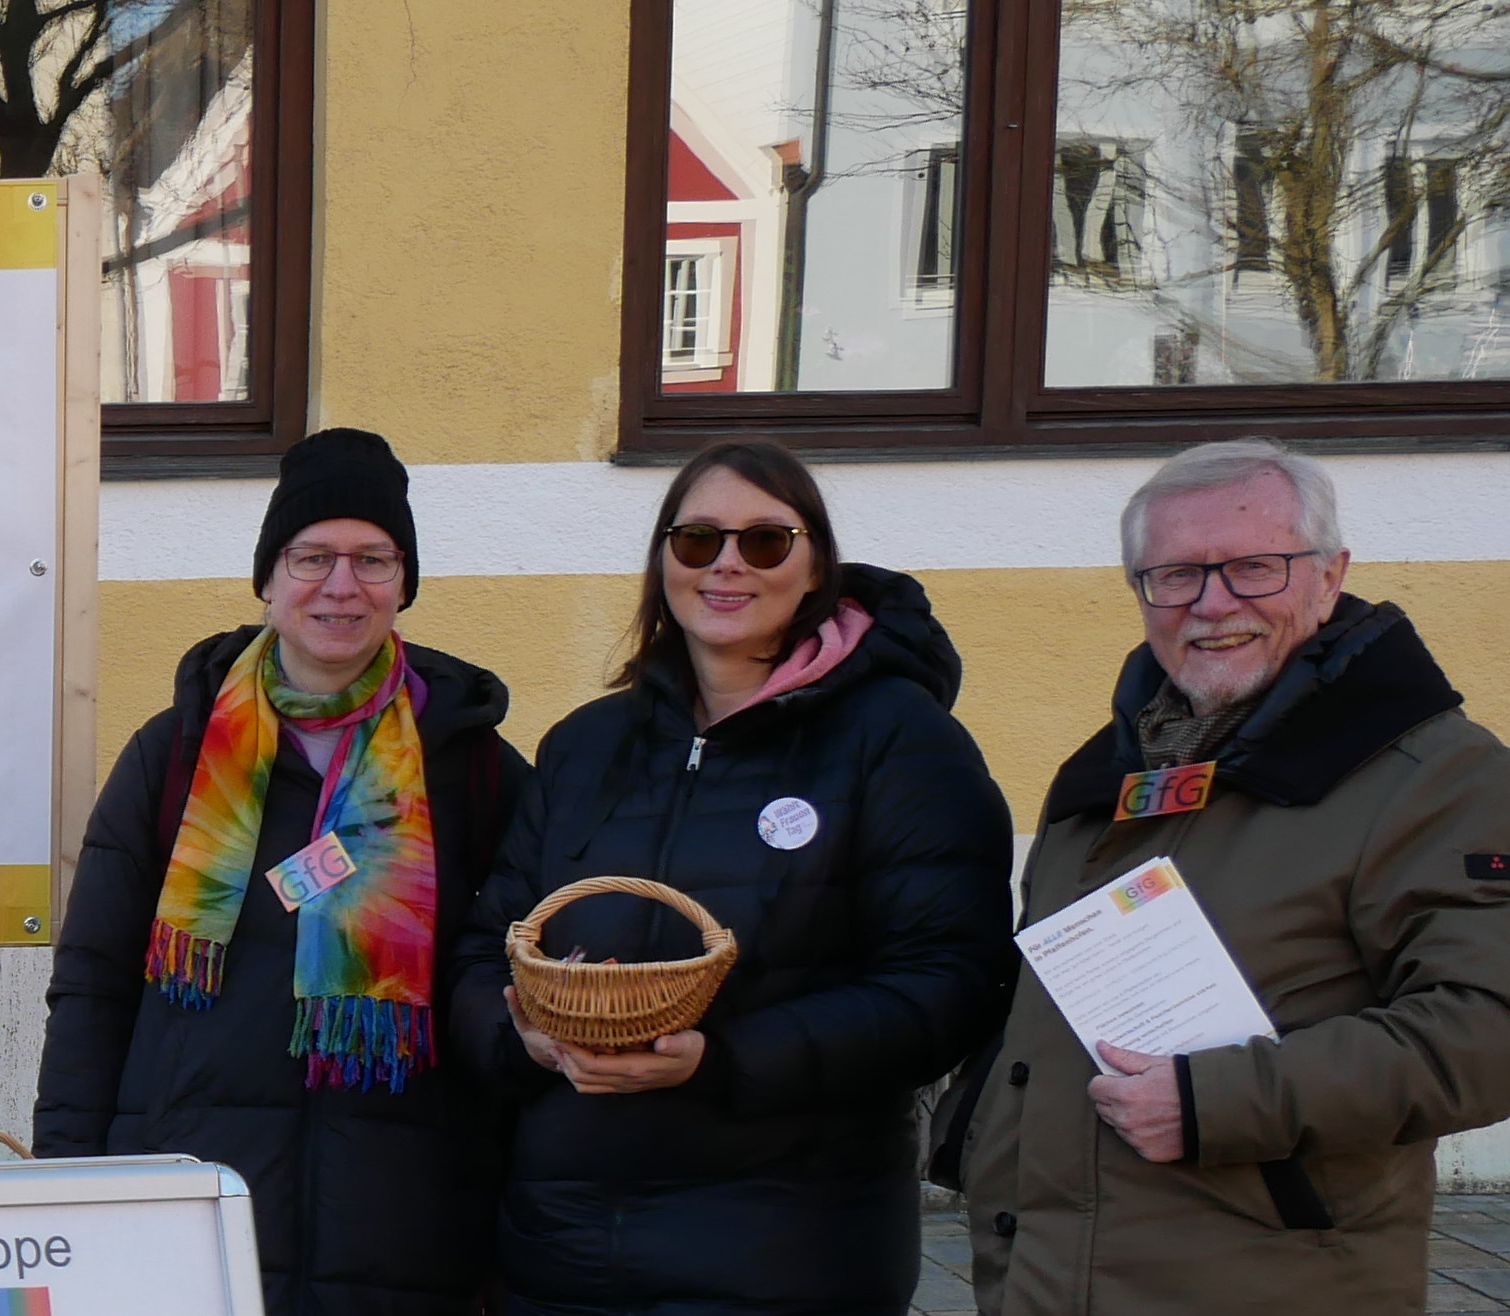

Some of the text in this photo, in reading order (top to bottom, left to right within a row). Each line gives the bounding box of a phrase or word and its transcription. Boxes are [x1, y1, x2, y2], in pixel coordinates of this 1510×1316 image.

[1121, 773, 1208, 815] GfG
[278, 845, 350, 903] GfG
[1124, 877, 1156, 901] GfG
